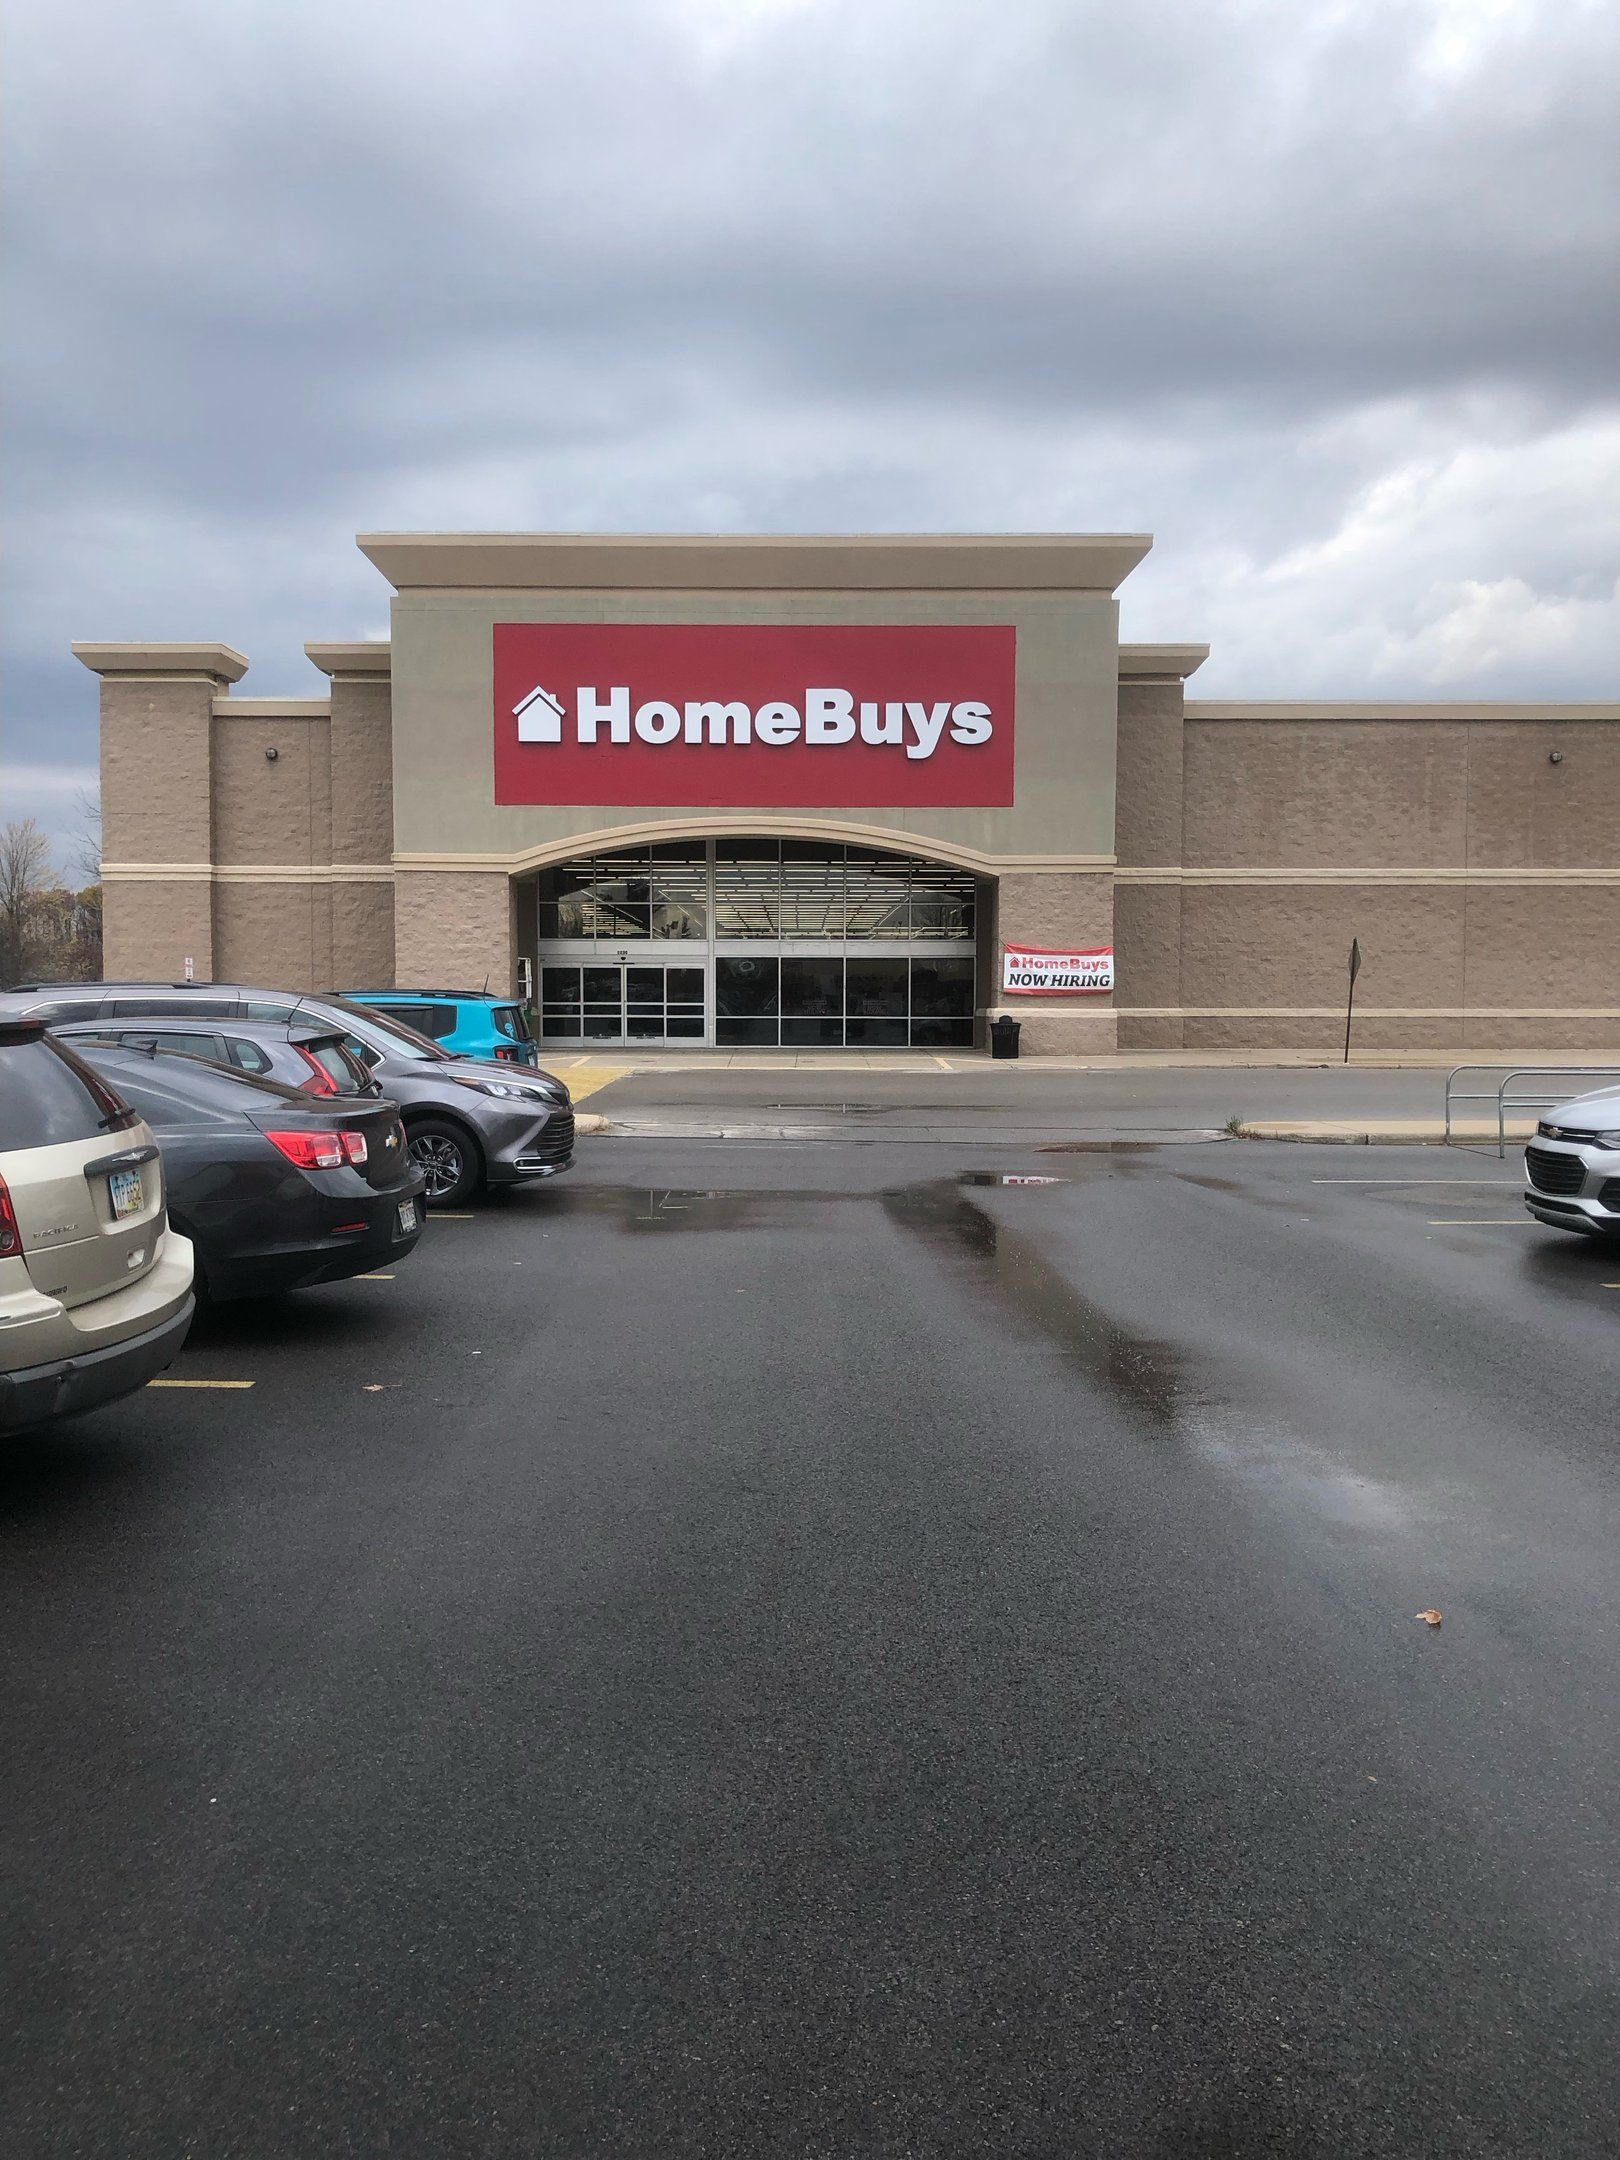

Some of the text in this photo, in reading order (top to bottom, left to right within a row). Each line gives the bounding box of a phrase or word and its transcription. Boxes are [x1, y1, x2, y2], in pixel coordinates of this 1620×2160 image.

[577, 687, 993, 760] HomeBuys
[1022, 957, 1109, 972] HomeBuys
[1008, 973, 1110, 987] NOW HIRING
